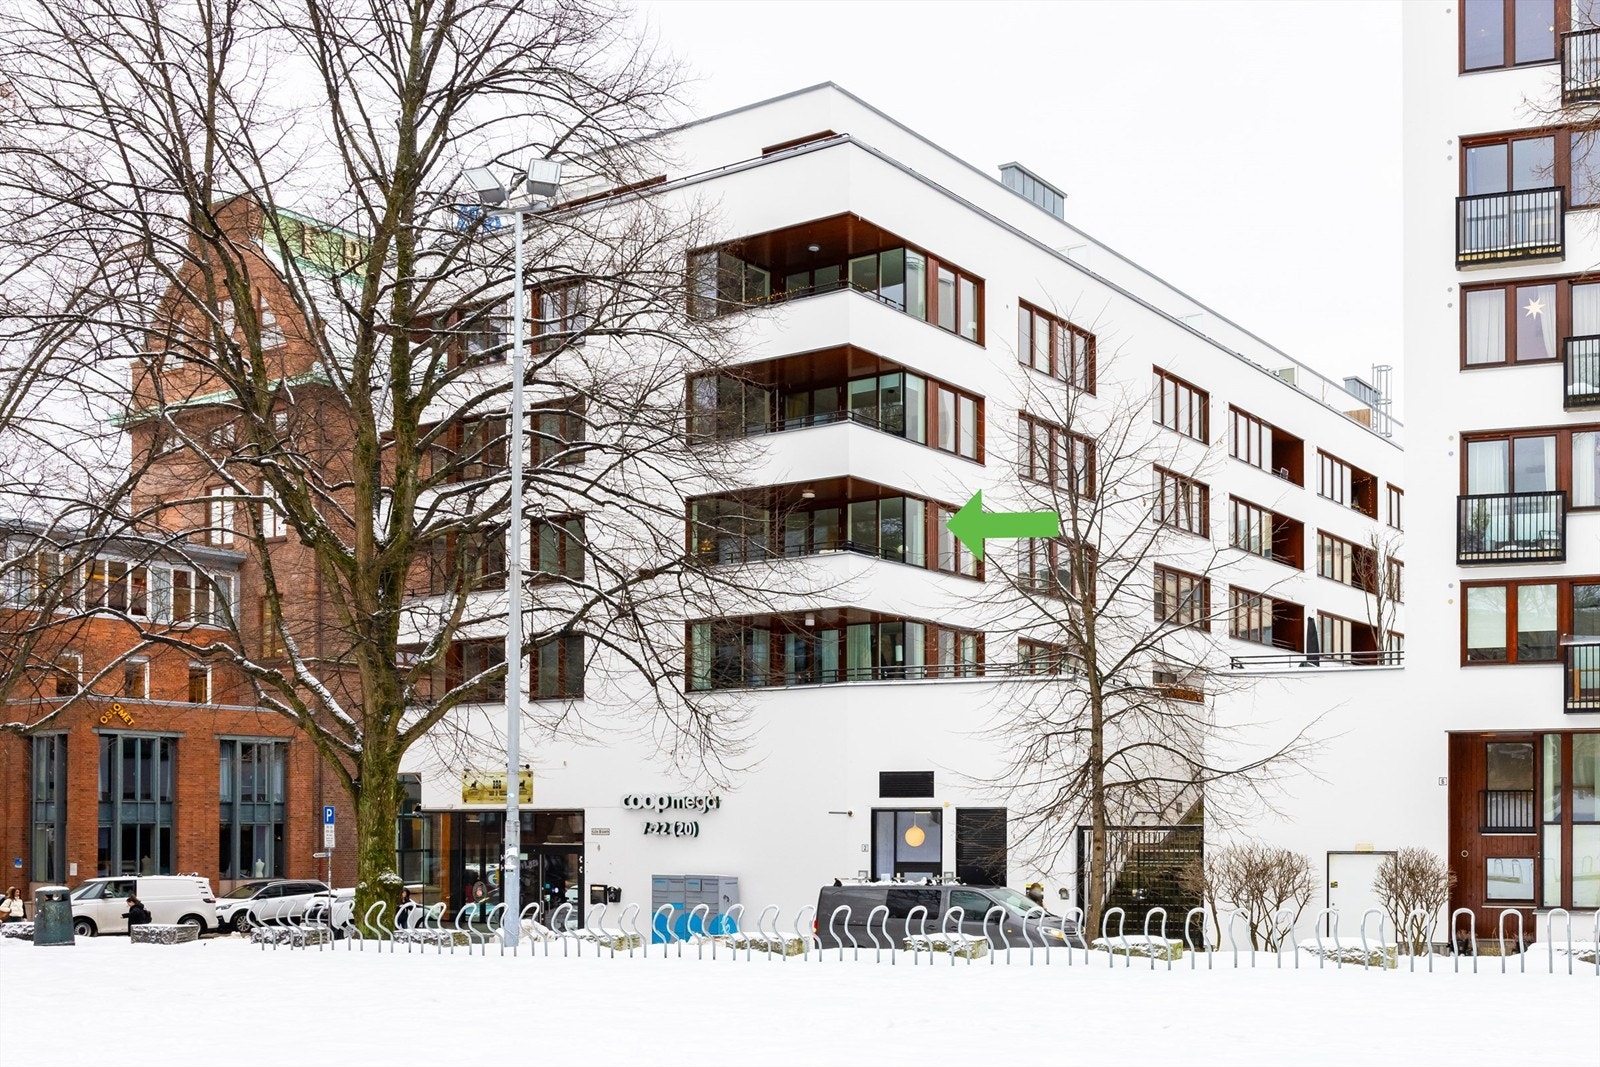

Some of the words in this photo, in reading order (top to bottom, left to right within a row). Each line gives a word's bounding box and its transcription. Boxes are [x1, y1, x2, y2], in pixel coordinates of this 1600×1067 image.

[621, 793, 671, 813] coop
[672, 795, 721, 814] mega
[673, 821, 700, 838] (20)
